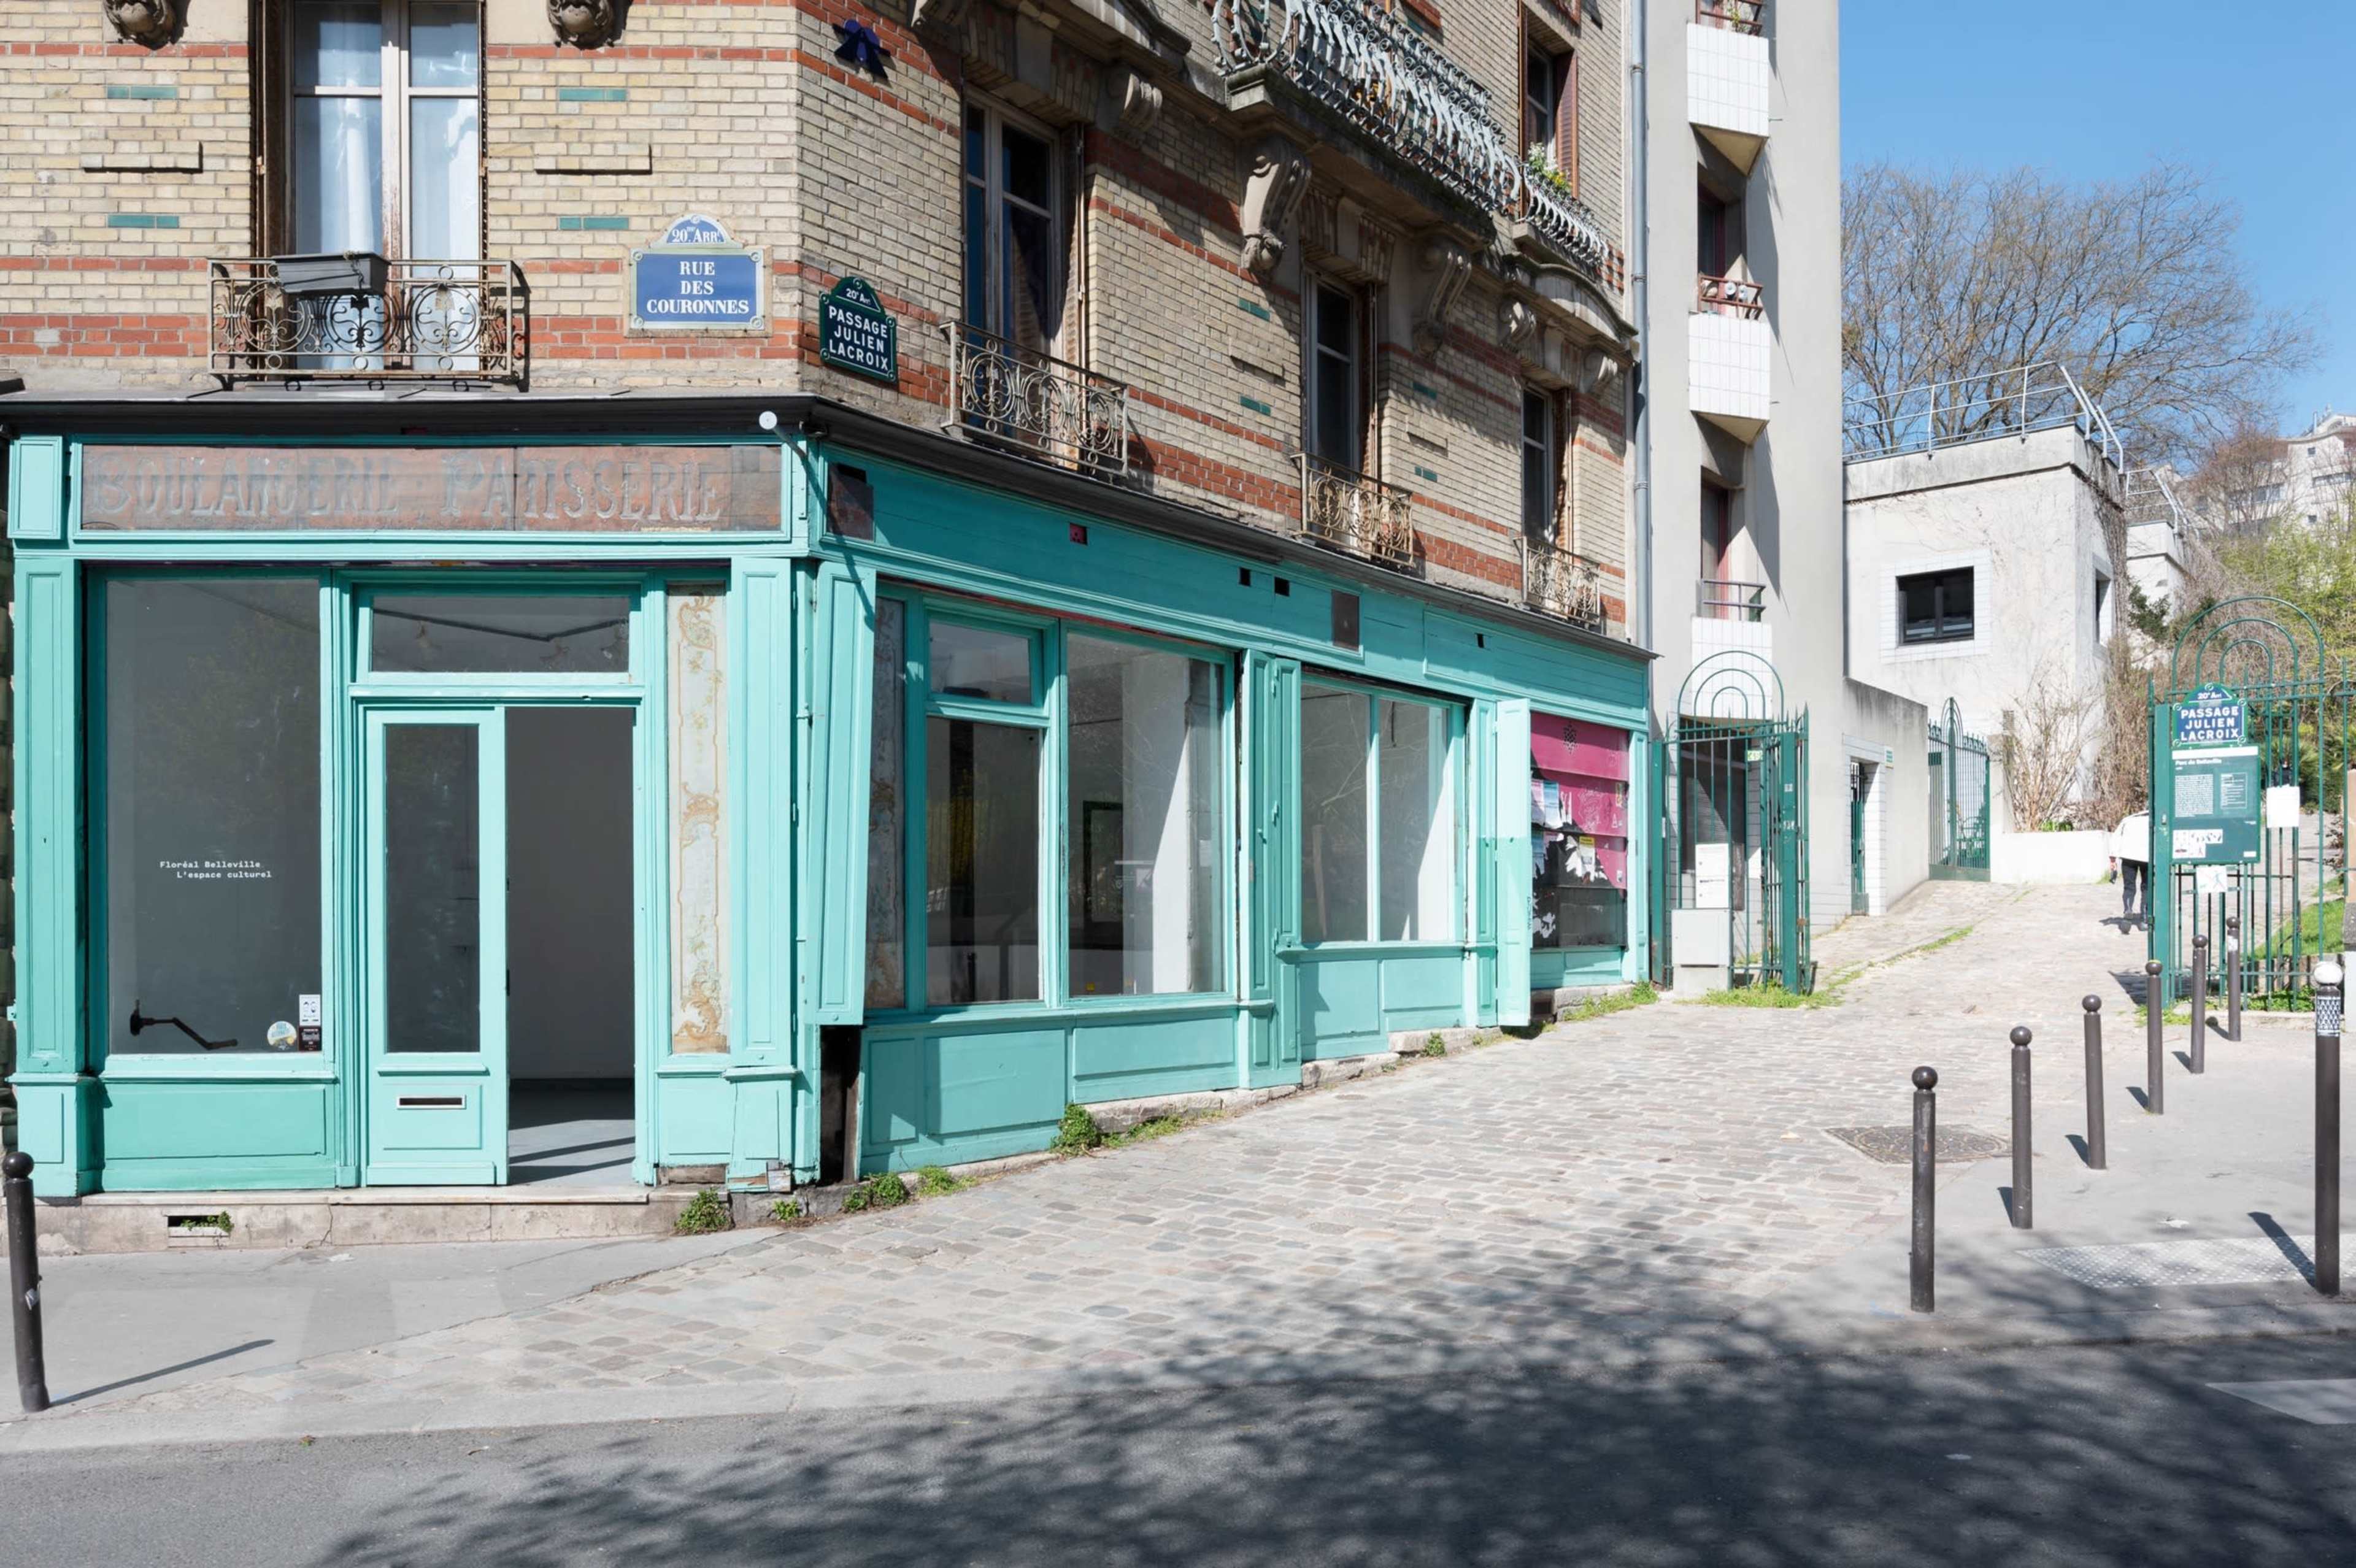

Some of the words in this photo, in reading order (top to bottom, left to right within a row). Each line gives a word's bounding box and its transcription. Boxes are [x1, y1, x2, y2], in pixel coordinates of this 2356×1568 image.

[680, 261, 715, 275] RUE
[680, 281, 714, 295] DES
[647, 299, 750, 315] COURONNES
[829, 306, 888, 338] PASSAGE
[834, 325, 884, 353] JULIEN
[829, 339, 888, 371] LACROIX
[91, 452, 400, 517] BOULANGERIE
[2181, 706, 2239, 719] PASSAGE
[2185, 718, 2235, 729] JULIEN
[2181, 728, 2239, 741] LACROIX
